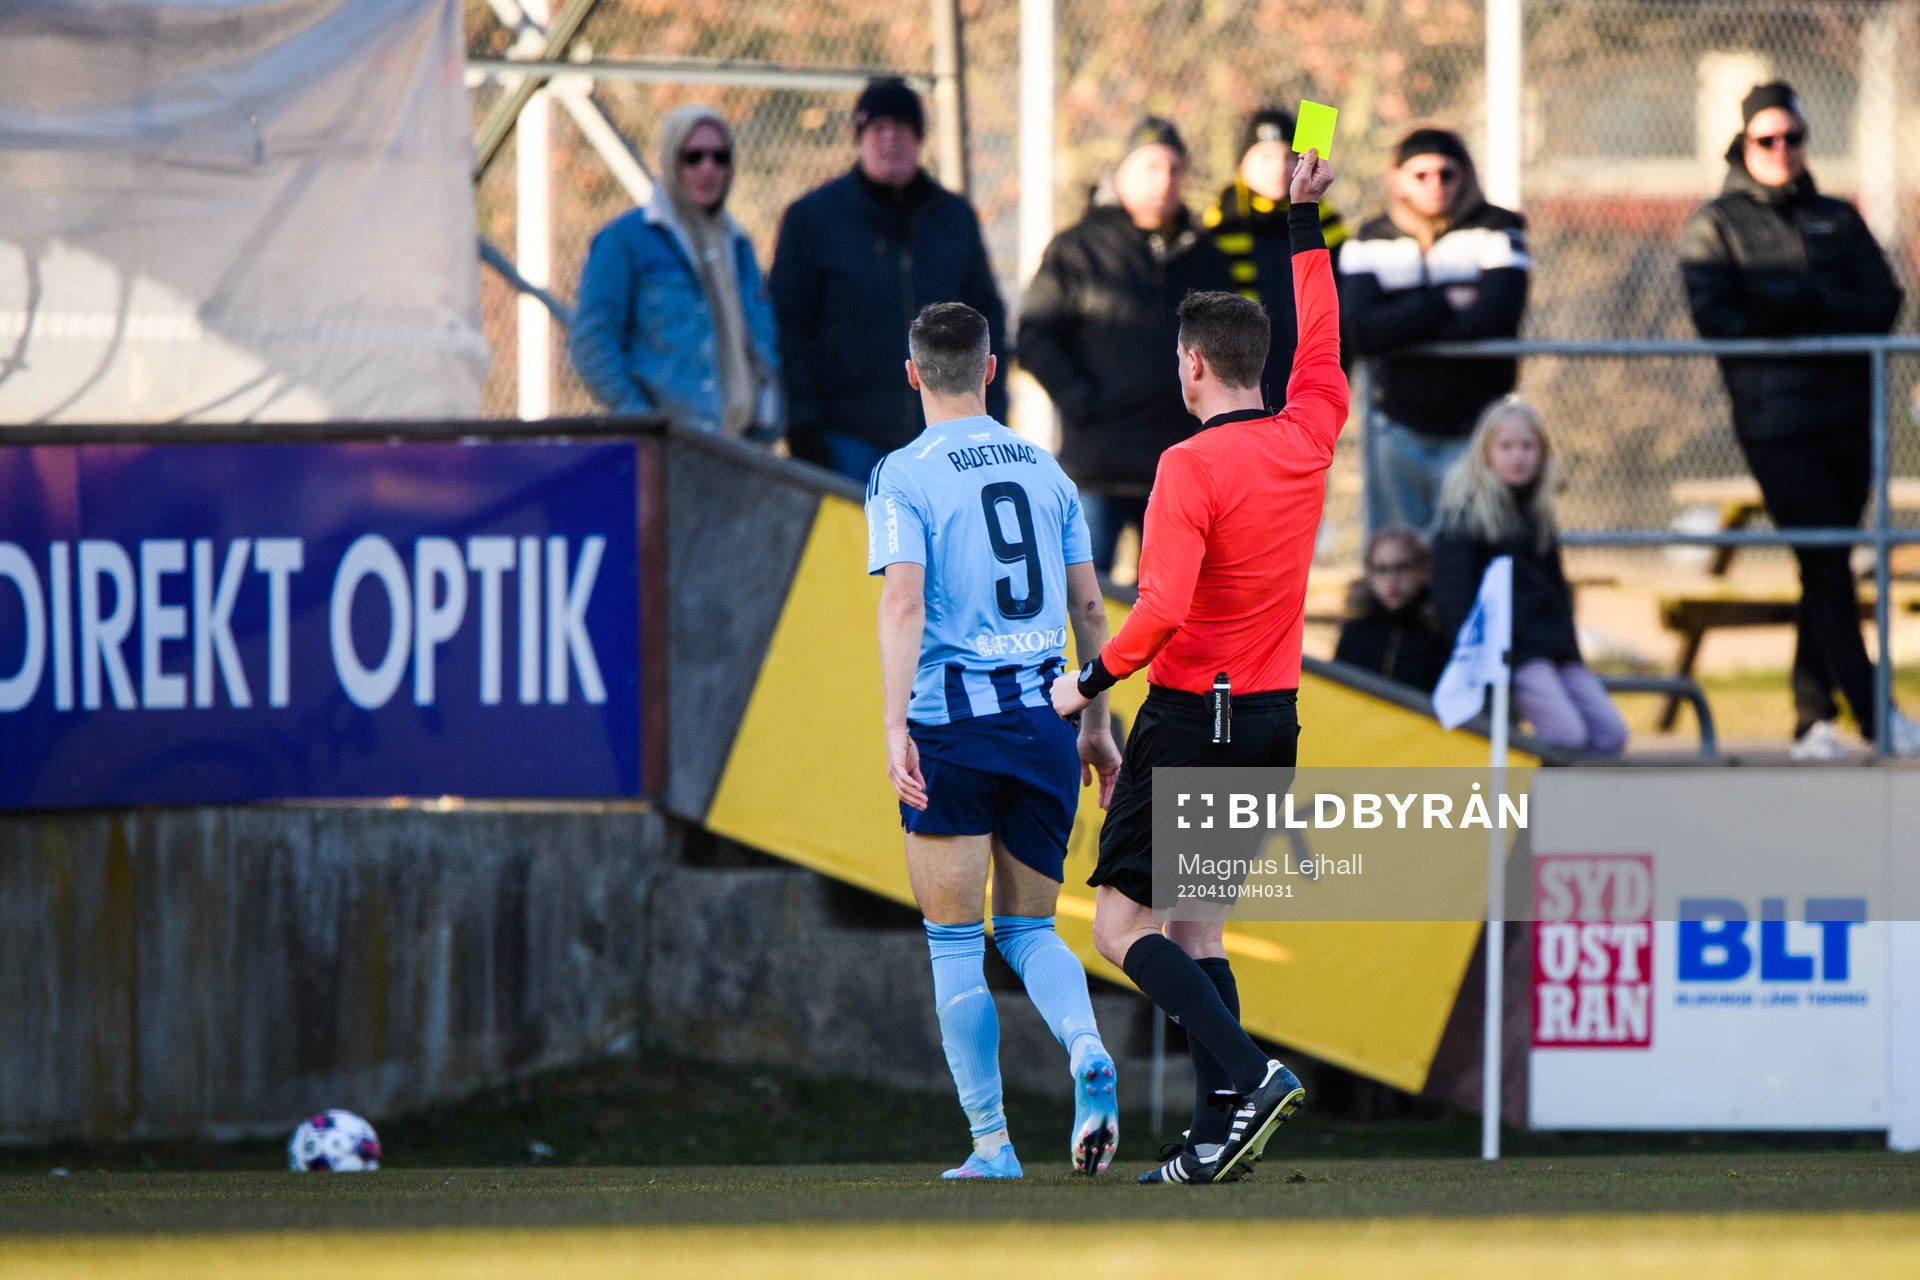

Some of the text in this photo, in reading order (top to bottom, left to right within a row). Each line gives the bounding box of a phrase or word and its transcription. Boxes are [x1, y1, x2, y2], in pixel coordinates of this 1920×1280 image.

[947, 443, 1037, 472] RADETINAC
[980, 481, 1044, 620] 9
[0, 534, 607, 712] DIREKT OPTIK
[1539, 861, 1650, 921] SYD
[1678, 898, 1866, 981] BLT
[1538, 983, 1650, 1042] RAN
